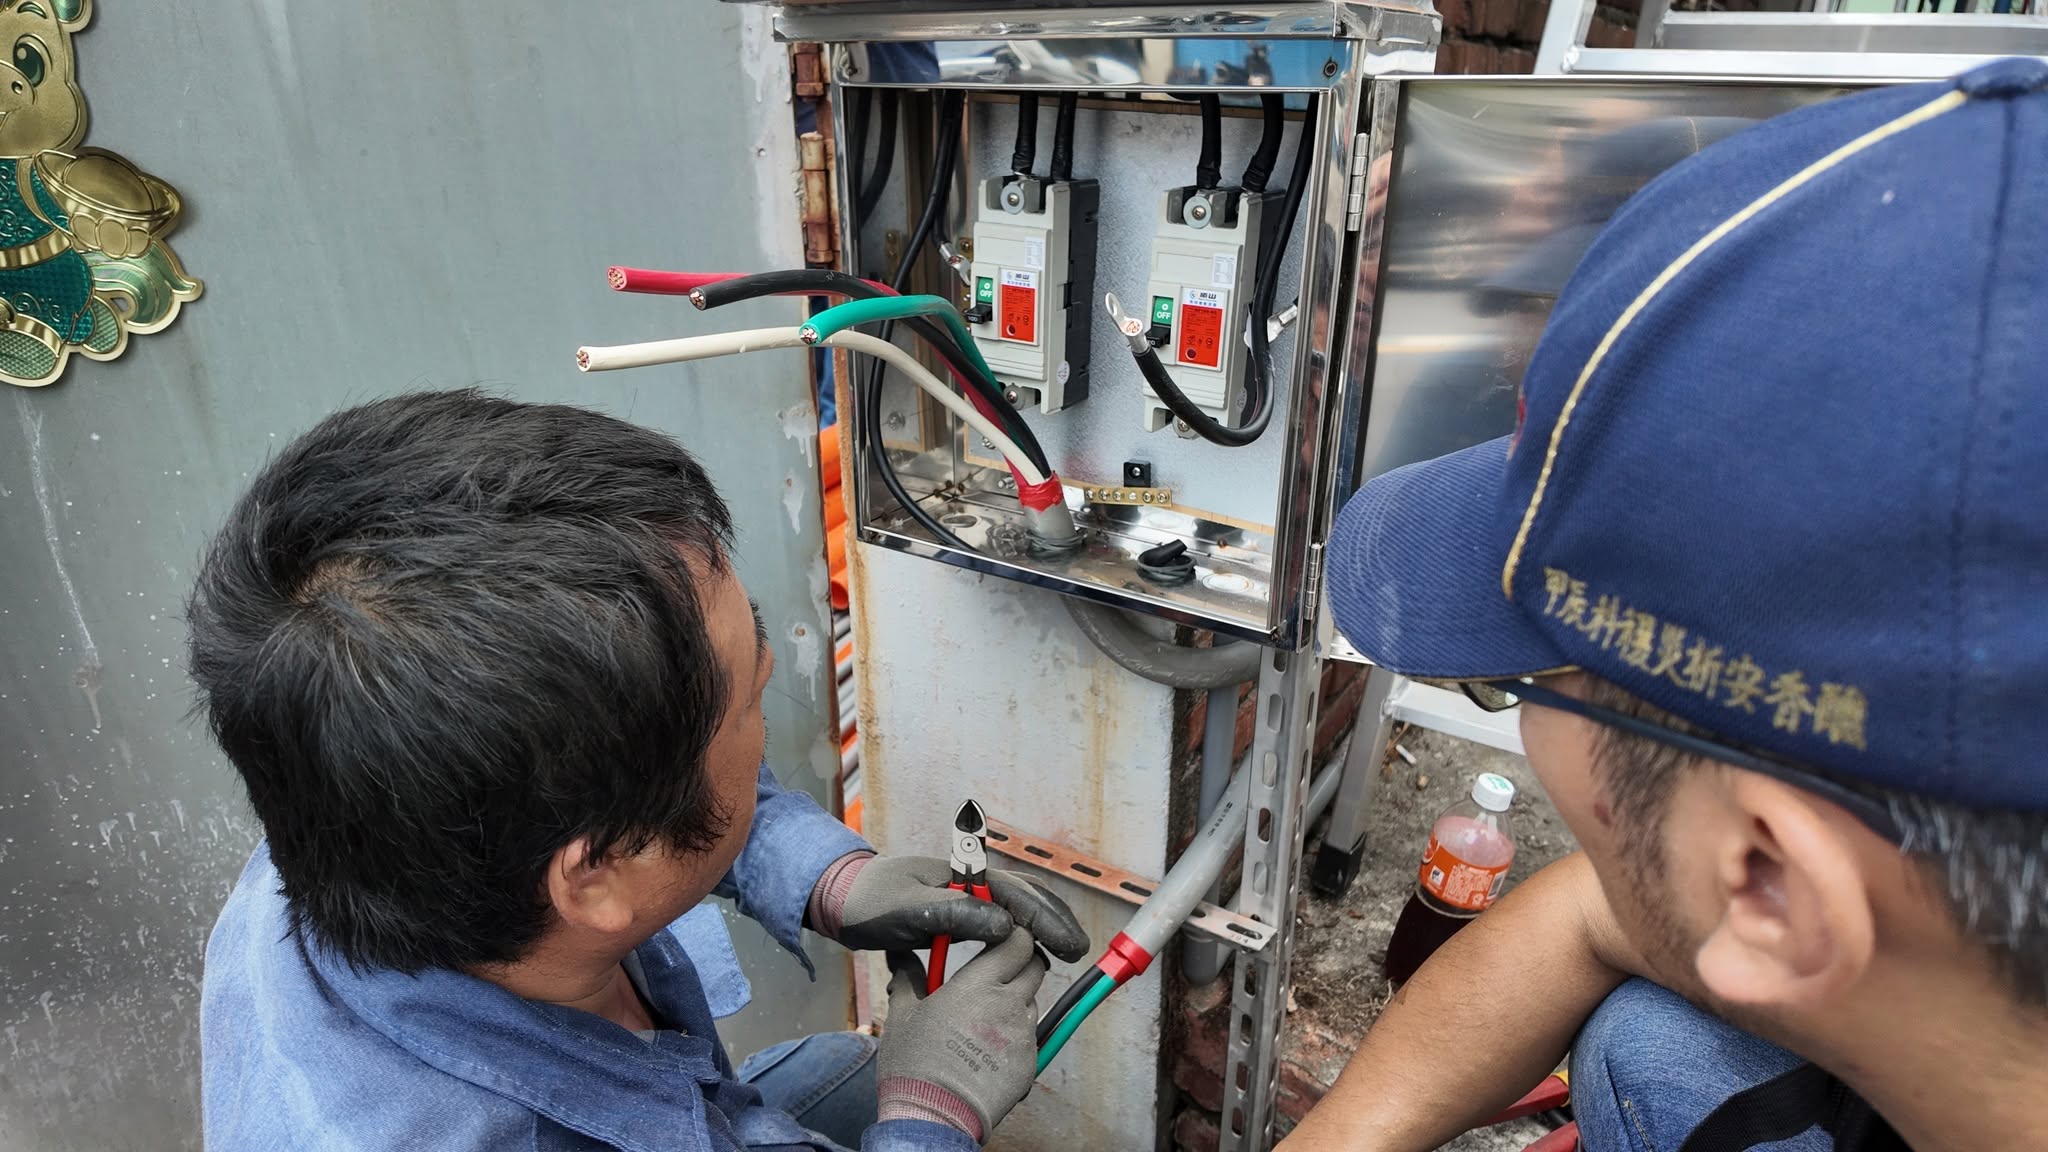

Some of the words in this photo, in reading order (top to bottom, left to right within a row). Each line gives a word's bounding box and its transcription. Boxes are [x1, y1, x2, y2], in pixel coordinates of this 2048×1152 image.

[980, 290, 993, 298] OFF
[1156, 311, 1171, 320] OFF
[946, 1039, 981, 1073] Gloves
[981, 1052, 1000, 1073] Grip
